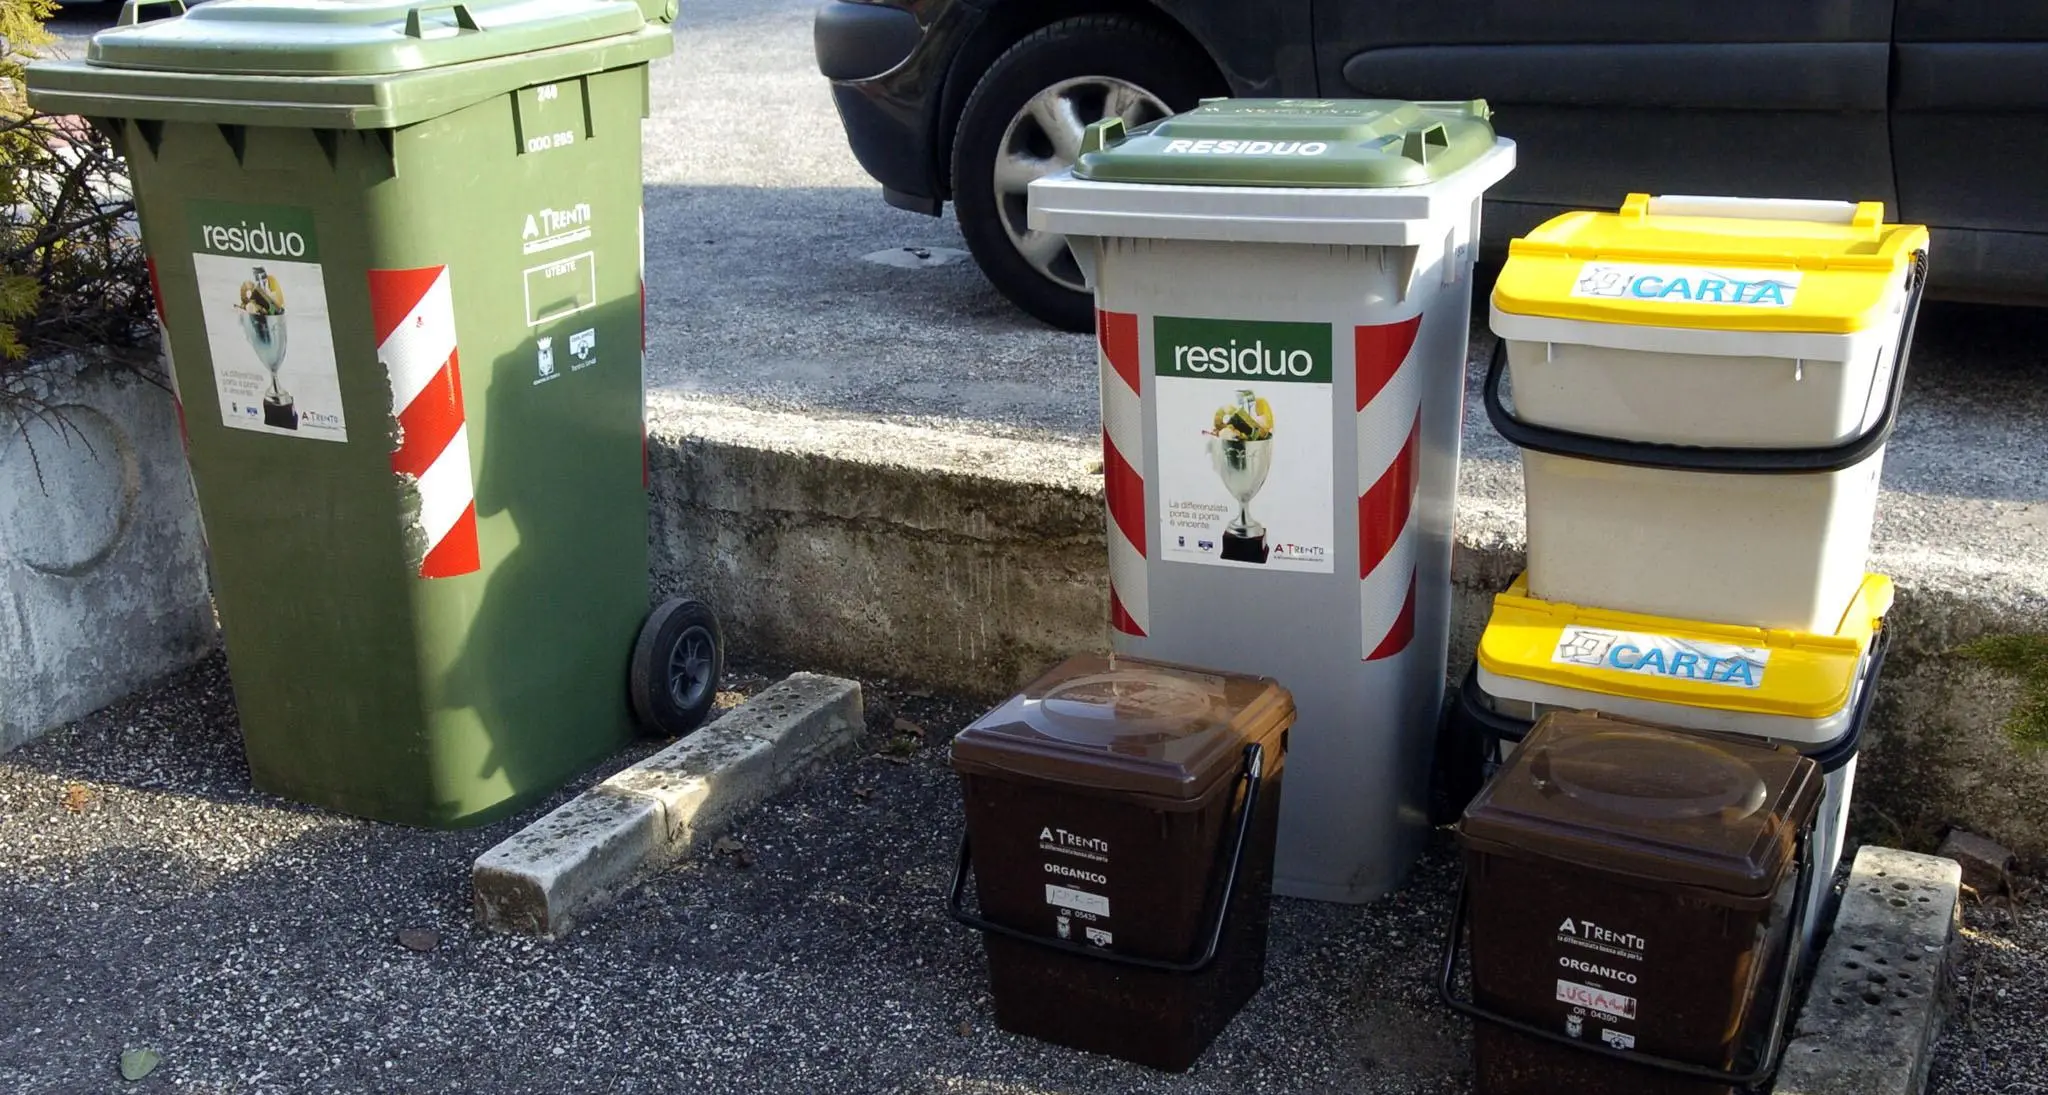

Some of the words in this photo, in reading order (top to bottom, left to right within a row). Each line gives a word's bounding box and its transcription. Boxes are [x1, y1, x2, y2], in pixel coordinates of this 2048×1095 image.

[1163, 139, 1328, 156] RESIDUO
[202, 220, 306, 257] residuo
[522, 213, 540, 240] A
[1631, 275, 1785, 305] CARTA
[1174, 338, 1314, 377] residuo
[1274, 543, 1284, 553] A
[1287, 543, 1324, 556] TRENTO
[1608, 644, 1753, 686] CARTA
[1039, 826, 1054, 842] A
[1055, 828, 1108, 852] TRENTO
[1044, 863, 1107, 885] ORGANICO
[1559, 917, 1576, 935] A
[1580, 920, 1644, 950] TRENTO
[1559, 956, 1638, 985] ORGANICO
[1573, 1006, 1586, 1016] OR
